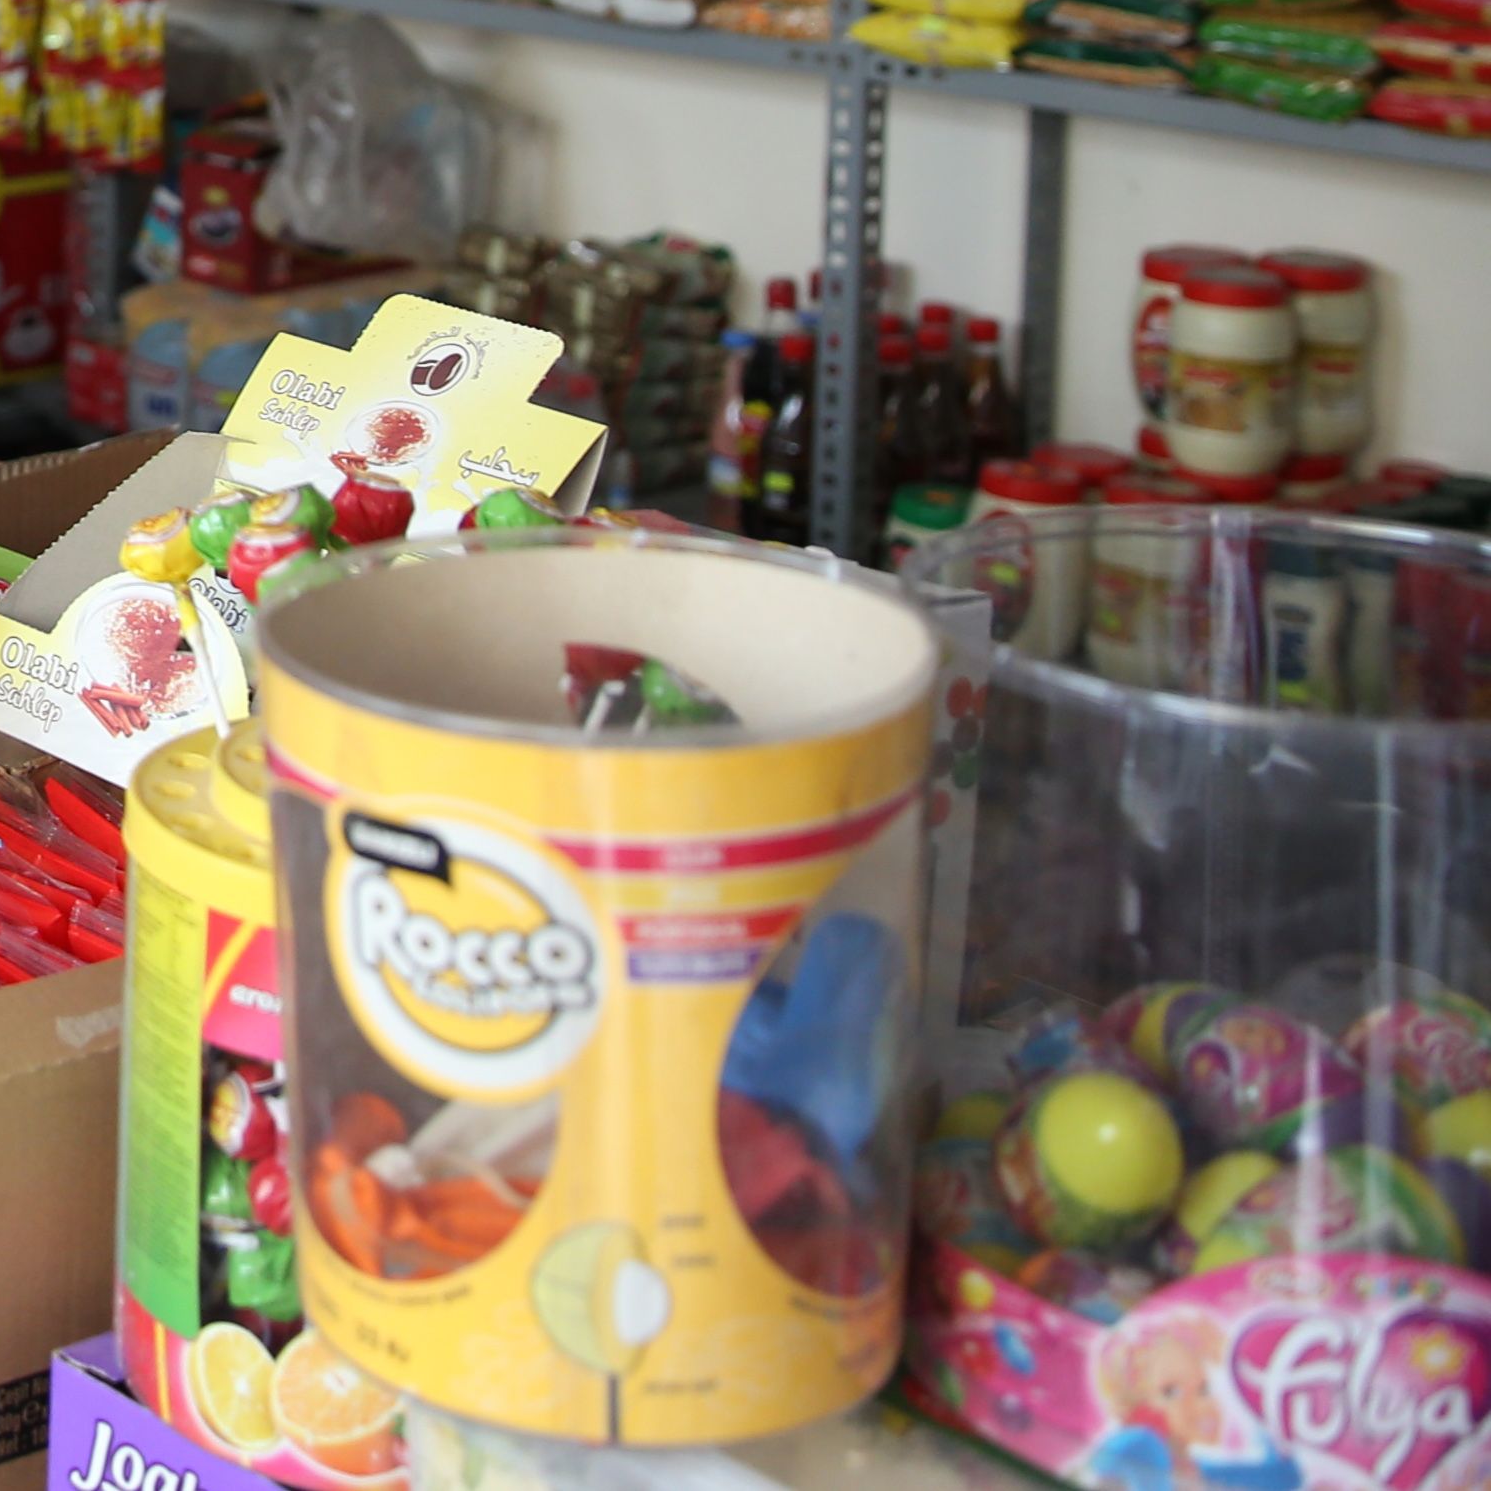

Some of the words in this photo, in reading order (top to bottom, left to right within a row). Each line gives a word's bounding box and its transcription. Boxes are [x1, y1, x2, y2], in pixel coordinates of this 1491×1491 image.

[270, 369, 346, 411] Olabi
[259, 398, 320, 440] Sahlep
[0, 636, 80, 695] Olabi
[354, 867, 595, 988] Rocco
